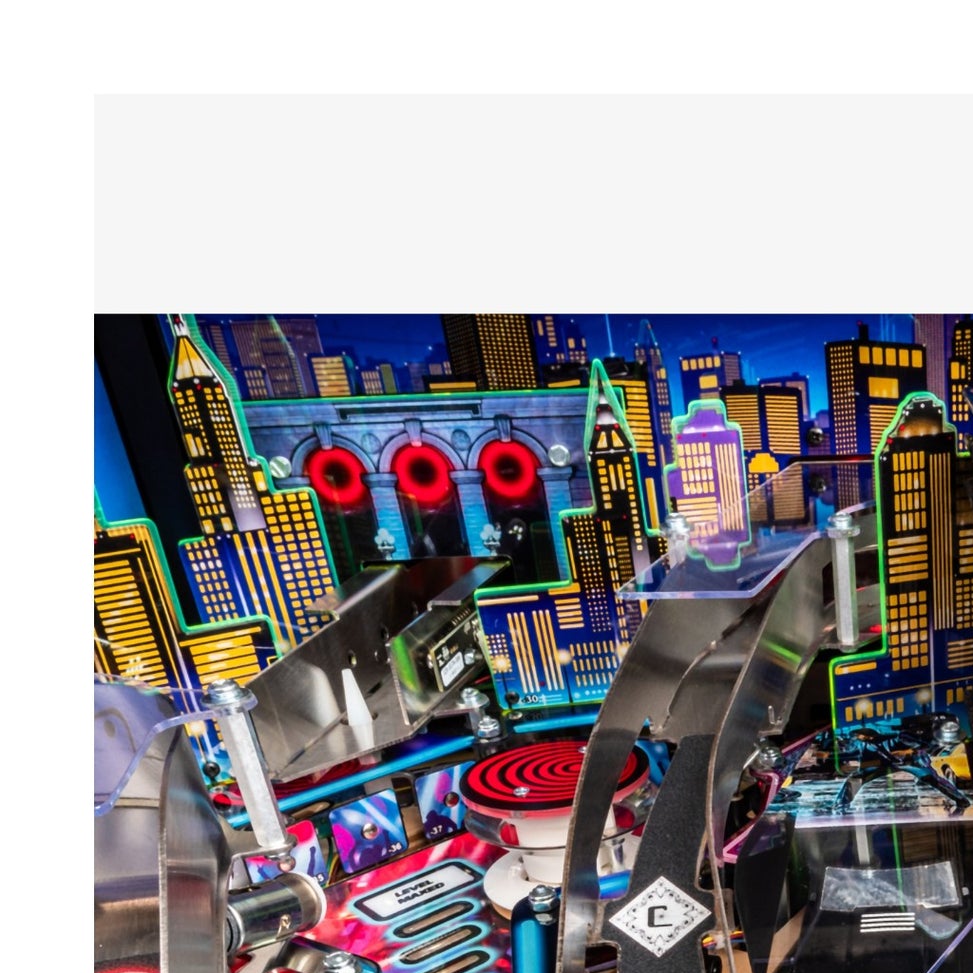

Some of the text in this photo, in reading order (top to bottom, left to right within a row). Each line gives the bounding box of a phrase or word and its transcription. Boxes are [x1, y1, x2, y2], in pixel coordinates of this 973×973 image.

[394, 880, 434, 897] LEVEL
[398, 882, 445, 904] MAXED
[647, 905, 673, 928] C
